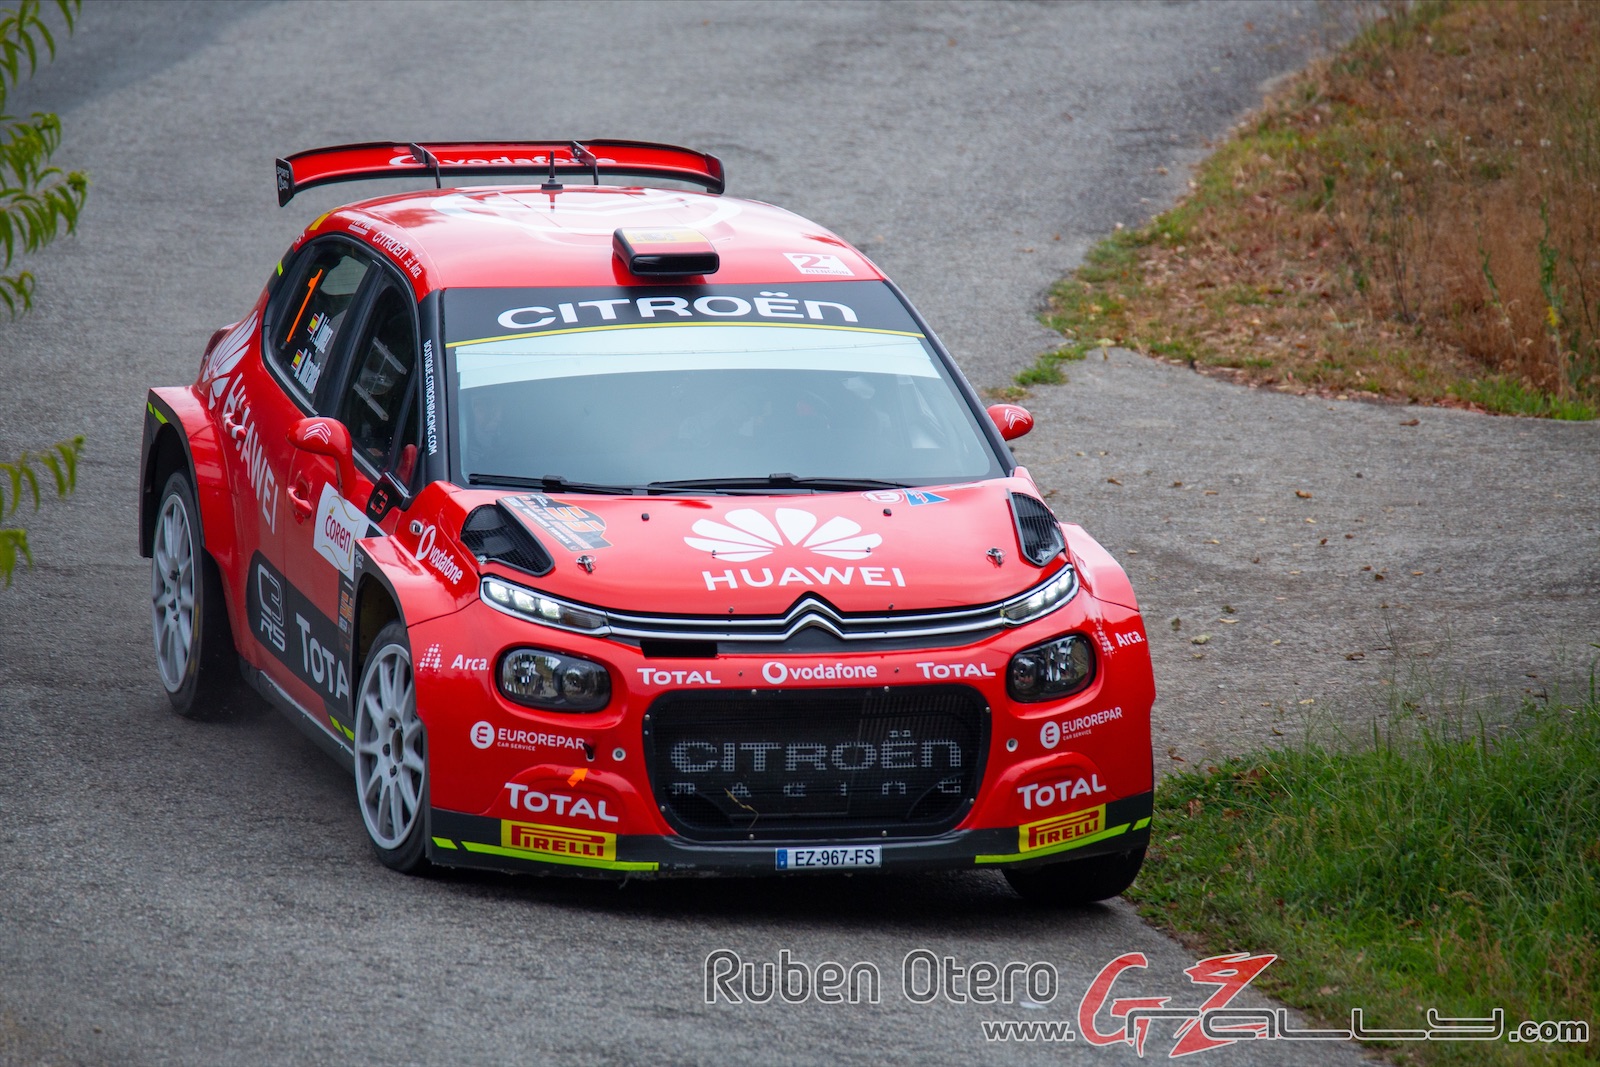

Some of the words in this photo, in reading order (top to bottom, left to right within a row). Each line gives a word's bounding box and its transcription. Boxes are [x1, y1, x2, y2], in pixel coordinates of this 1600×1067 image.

[442, 156, 616, 165] vodafoe
[498, 291, 858, 329] CITROËN
[428, 545, 463, 585] vodafone
[702, 566, 906, 591] HUAWEI
[260, 611, 286, 653] RS
[637, 668, 721, 685] TOTAL
[789, 662, 878, 680] vodafone
[916, 662, 996, 679] TOTAL
[511, 743, 536, 752] SERVICE
[1072, 729, 1092, 738] SERVICE
[670, 729, 962, 773] CITROËN
[504, 782, 619, 823] TOTAL
[1017, 773, 1107, 810] TOTAL
[511, 824, 606, 857] PIRELLI
[1028, 809, 1100, 848] PIRELLI
[795, 849, 876, 867] EZ-967-FS
